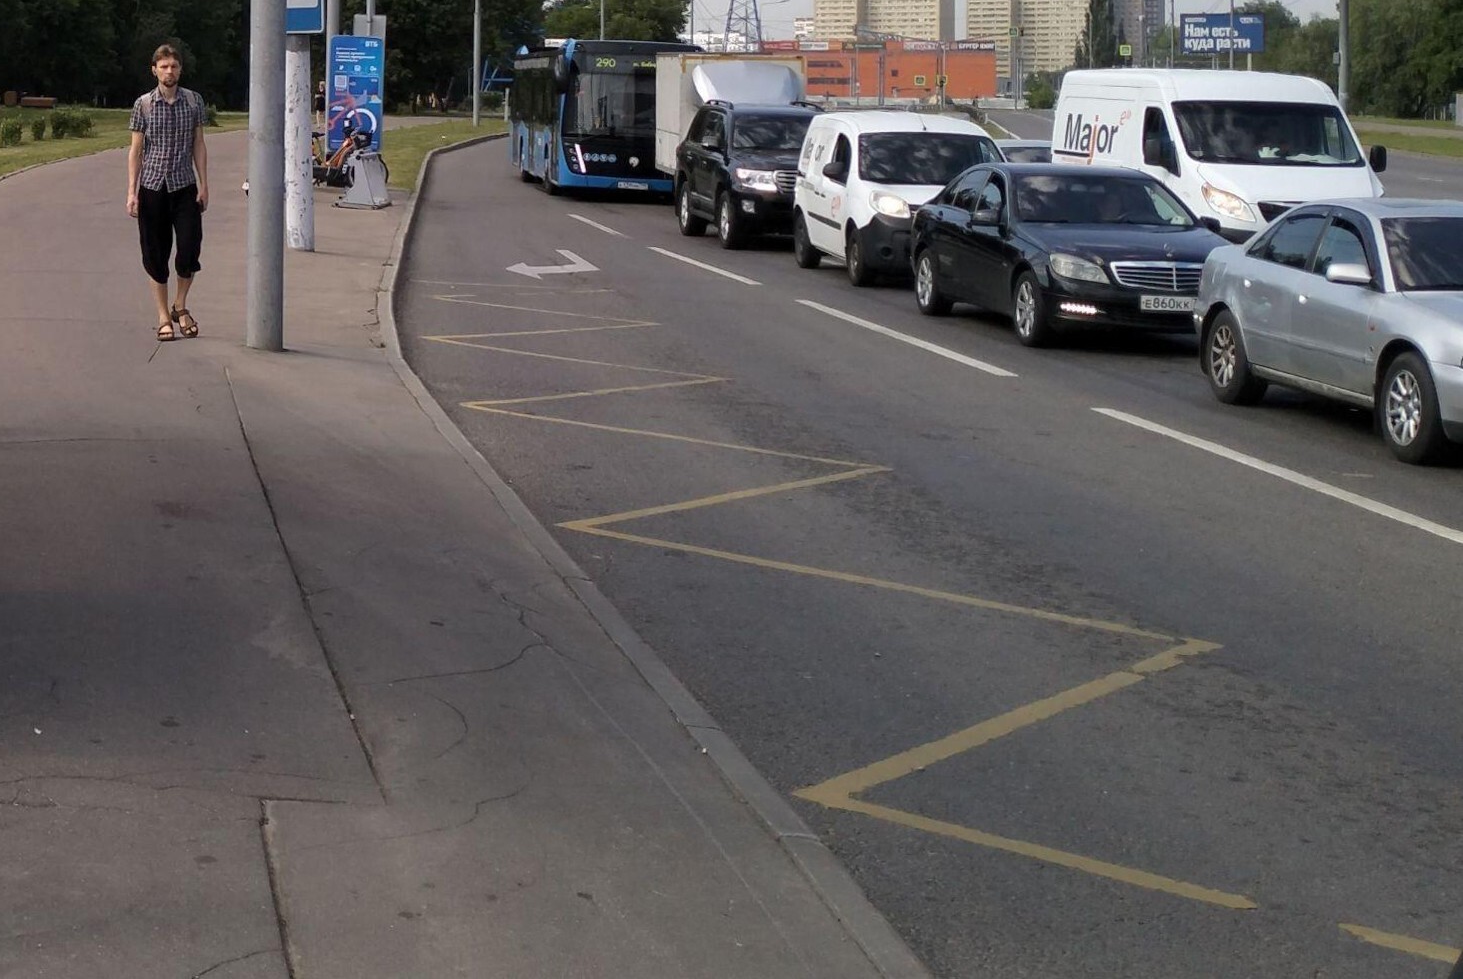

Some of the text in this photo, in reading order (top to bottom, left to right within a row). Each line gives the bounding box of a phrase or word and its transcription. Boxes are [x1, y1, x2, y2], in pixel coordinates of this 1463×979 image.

[1184, 23, 1209, 37] Нам
[1184, 38, 1214, 52] куда
[596, 57, 616, 68] 290
[1063, 113, 1119, 165] Major
